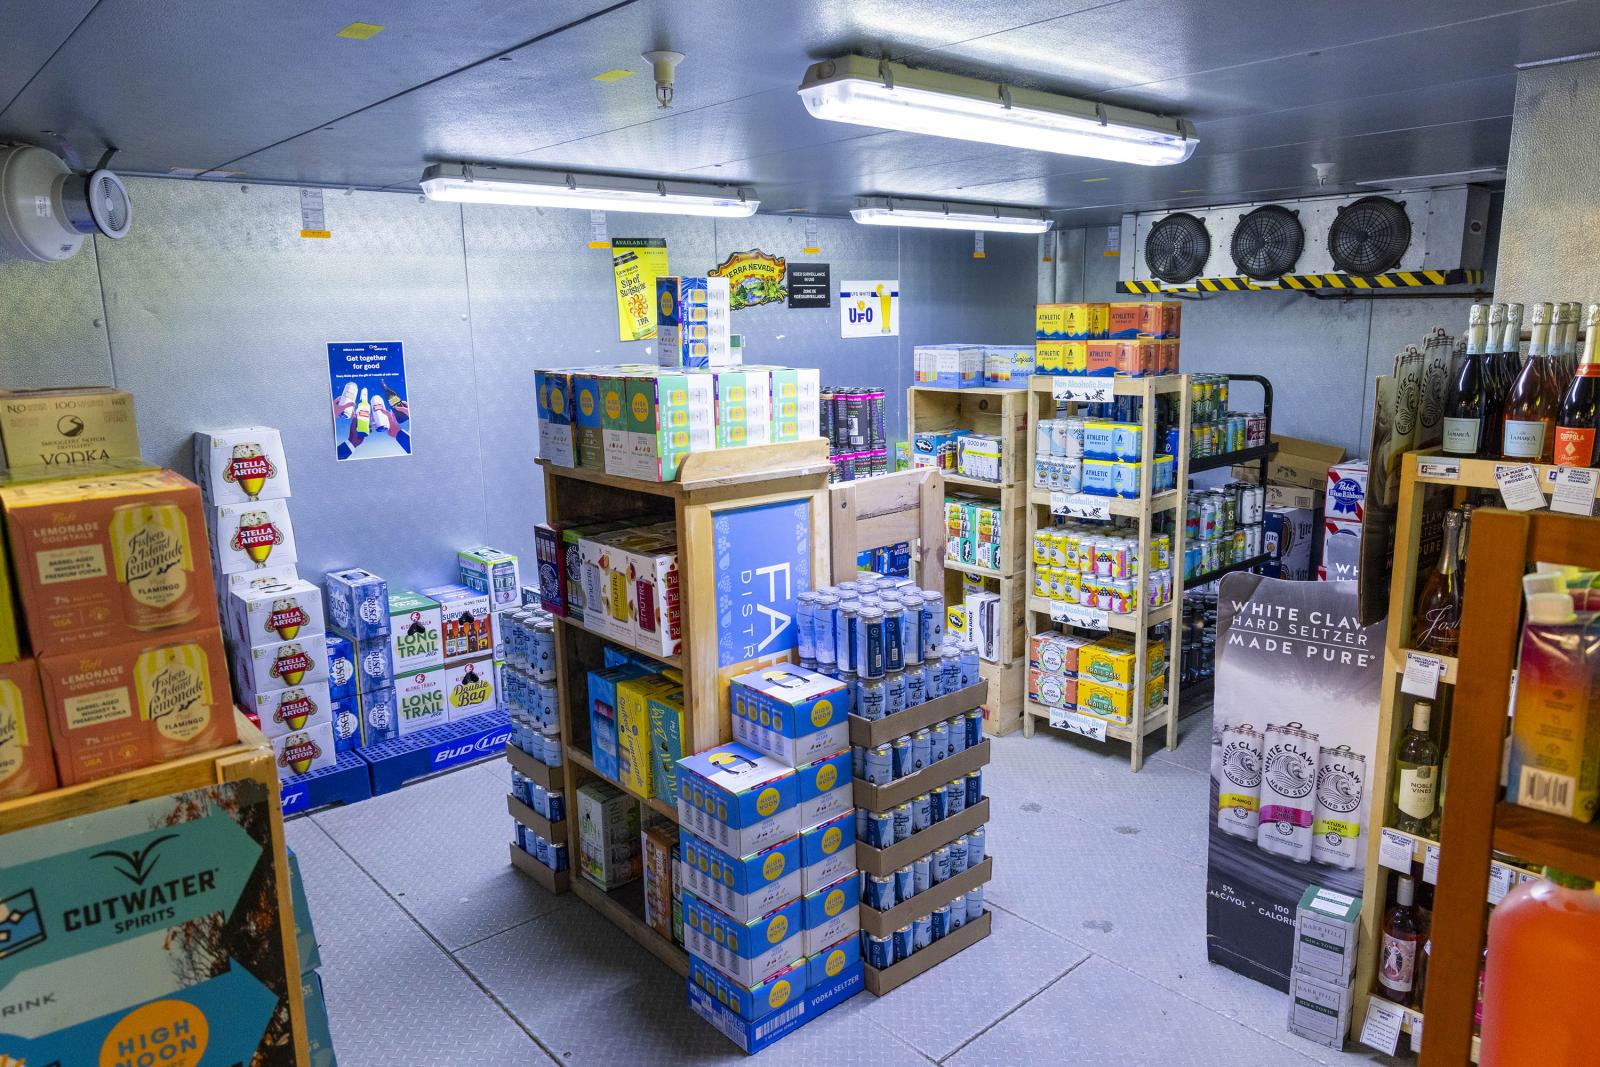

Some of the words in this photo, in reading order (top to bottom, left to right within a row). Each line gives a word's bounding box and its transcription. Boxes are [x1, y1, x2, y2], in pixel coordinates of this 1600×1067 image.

[749, 263, 775, 274] NEVADA
[621, 277, 632, 288] Sip
[632, 274, 641, 284] of
[620, 283, 646, 298] Sunshine
[637, 316, 650, 327] IPA
[360, 354, 387, 363] together
[364, 363, 380, 371] good
[1097, 381, 1113, 389] Beer
[7, 404, 26, 414] NO
[55, 402, 76, 411] 100
[1086, 434, 1109, 442] ATHLETIC
[1560, 432, 1585, 442] COPPOLA
[40, 449, 110, 467] VODKA
[233, 459, 266, 470] STELLA
[233, 466, 268, 477] ARTOIS
[1085, 469, 1109, 478] ATHLETIC
[1504, 474, 1533, 486] PROSECCO
[1338, 482, 1356, 492] Pabst
[1329, 489, 1343, 498] Blue
[1343, 489, 1364, 501] Ribbon
[1094, 497, 1109, 507] Beer
[1228, 509, 1234, 521] 8
[33, 521, 99, 539] LEMONADE
[240, 527, 273, 538] STELLA
[1300, 522, 1313, 540] Lite
[129, 529, 165, 555] Fishers
[241, 534, 275, 545] ARTOIS
[1266, 532, 1278, 542] Lite
[138, 541, 171, 561] Island
[125, 543, 183, 583] Lemonade
[79, 567, 102, 577] VODKA
[138, 582, 180, 595] FLAMINGO
[272, 611, 301, 621] STELLA
[366, 597, 376, 625] BUSCH
[472, 606, 488, 616] PACK
[1231, 600, 1299, 622] WHITE
[273, 617, 303, 627] ARTOIS
[1232, 615, 1279, 632] HARD
[1288, 624, 1368, 646] SELTZER
[396, 629, 438, 649] LONG
[398, 641, 439, 659] TRAIL
[1229, 633, 1293, 655] MADE
[1306, 645, 1369, 668] PURE
[277, 656, 306, 666] STELLA
[278, 662, 307, 672] ARTOIS
[371, 650, 381, 678] BUSCH
[61, 665, 125, 686] LEMONADE
[335, 656, 346, 685] BUSCH
[152, 668, 187, 694] Fishers
[161, 677, 193, 700] Island
[452, 680, 489, 696] Double
[149, 680, 204, 721] Lemonade
[402, 689, 443, 709] LONG
[457, 690, 486, 708] Bag
[281, 701, 309, 711] STELLA
[282, 706, 310, 716] ARTOIS
[403, 703, 444, 720] TRAIL
[814, 707, 830, 715] HIGH
[105, 708, 128, 720] VODKA
[376, 703, 385, 731] BUSCH
[813, 711, 832, 722] NOON
[164, 716, 205, 731] FLAMINGO
[340, 711, 350, 740] BUSCH
[285, 745, 313, 756] STELLA
[286, 751, 315, 761] ARTOIS
[435, 744, 474, 764] BUD
[1222, 741, 1238, 767] WHITE
[1238, 741, 1264, 761] CLAW
[1264, 744, 1282, 774] WHITE
[1283, 743, 1314, 767] CLAW
[818, 776, 836, 786] NOON
[1227, 771, 1245, 785] HARD
[1315, 764, 1332, 791] WHITE
[1333, 763, 1361, 785] CLAW
[1269, 779, 1290, 795] HARD
[1292, 774, 1315, 797] SELTZER
[1410, 781, 1433, 790] NOBLE
[1411, 787, 1432, 795] VINES
[759, 799, 778, 810] NOON
[1231, 796, 1252, 806] MANGO
[1320, 796, 1338, 811] HARD
[1341, 790, 1362, 812] SELTZER
[1322, 819, 1348, 831] NATURAL
[1327, 825, 1342, 833] LIME
[1222, 884, 1235, 895] 5%
[63, 869, 216, 933] CUTWATER
[1273, 904, 1290, 915] 100
[114, 906, 176, 935] SPIRITS
[1258, 907, 1297, 927] CALORIE
[1302, 922, 1324, 933] BARR
[1325, 928, 1343, 938] HILL
[1320, 941, 1340, 951] TONIC
[811, 989, 834, 1008] VODKA
[833, 973, 860, 995] SELTZER
[1297, 984, 1318, 996] BARR
[1318, 990, 1337, 1002] HILL
[771, 991, 790, 1004] NOON
[1, 992, 57, 1017] RINK
[1315, 1004, 1335, 1015] TONIC
[117, 1017, 190, 1057] HIGH
